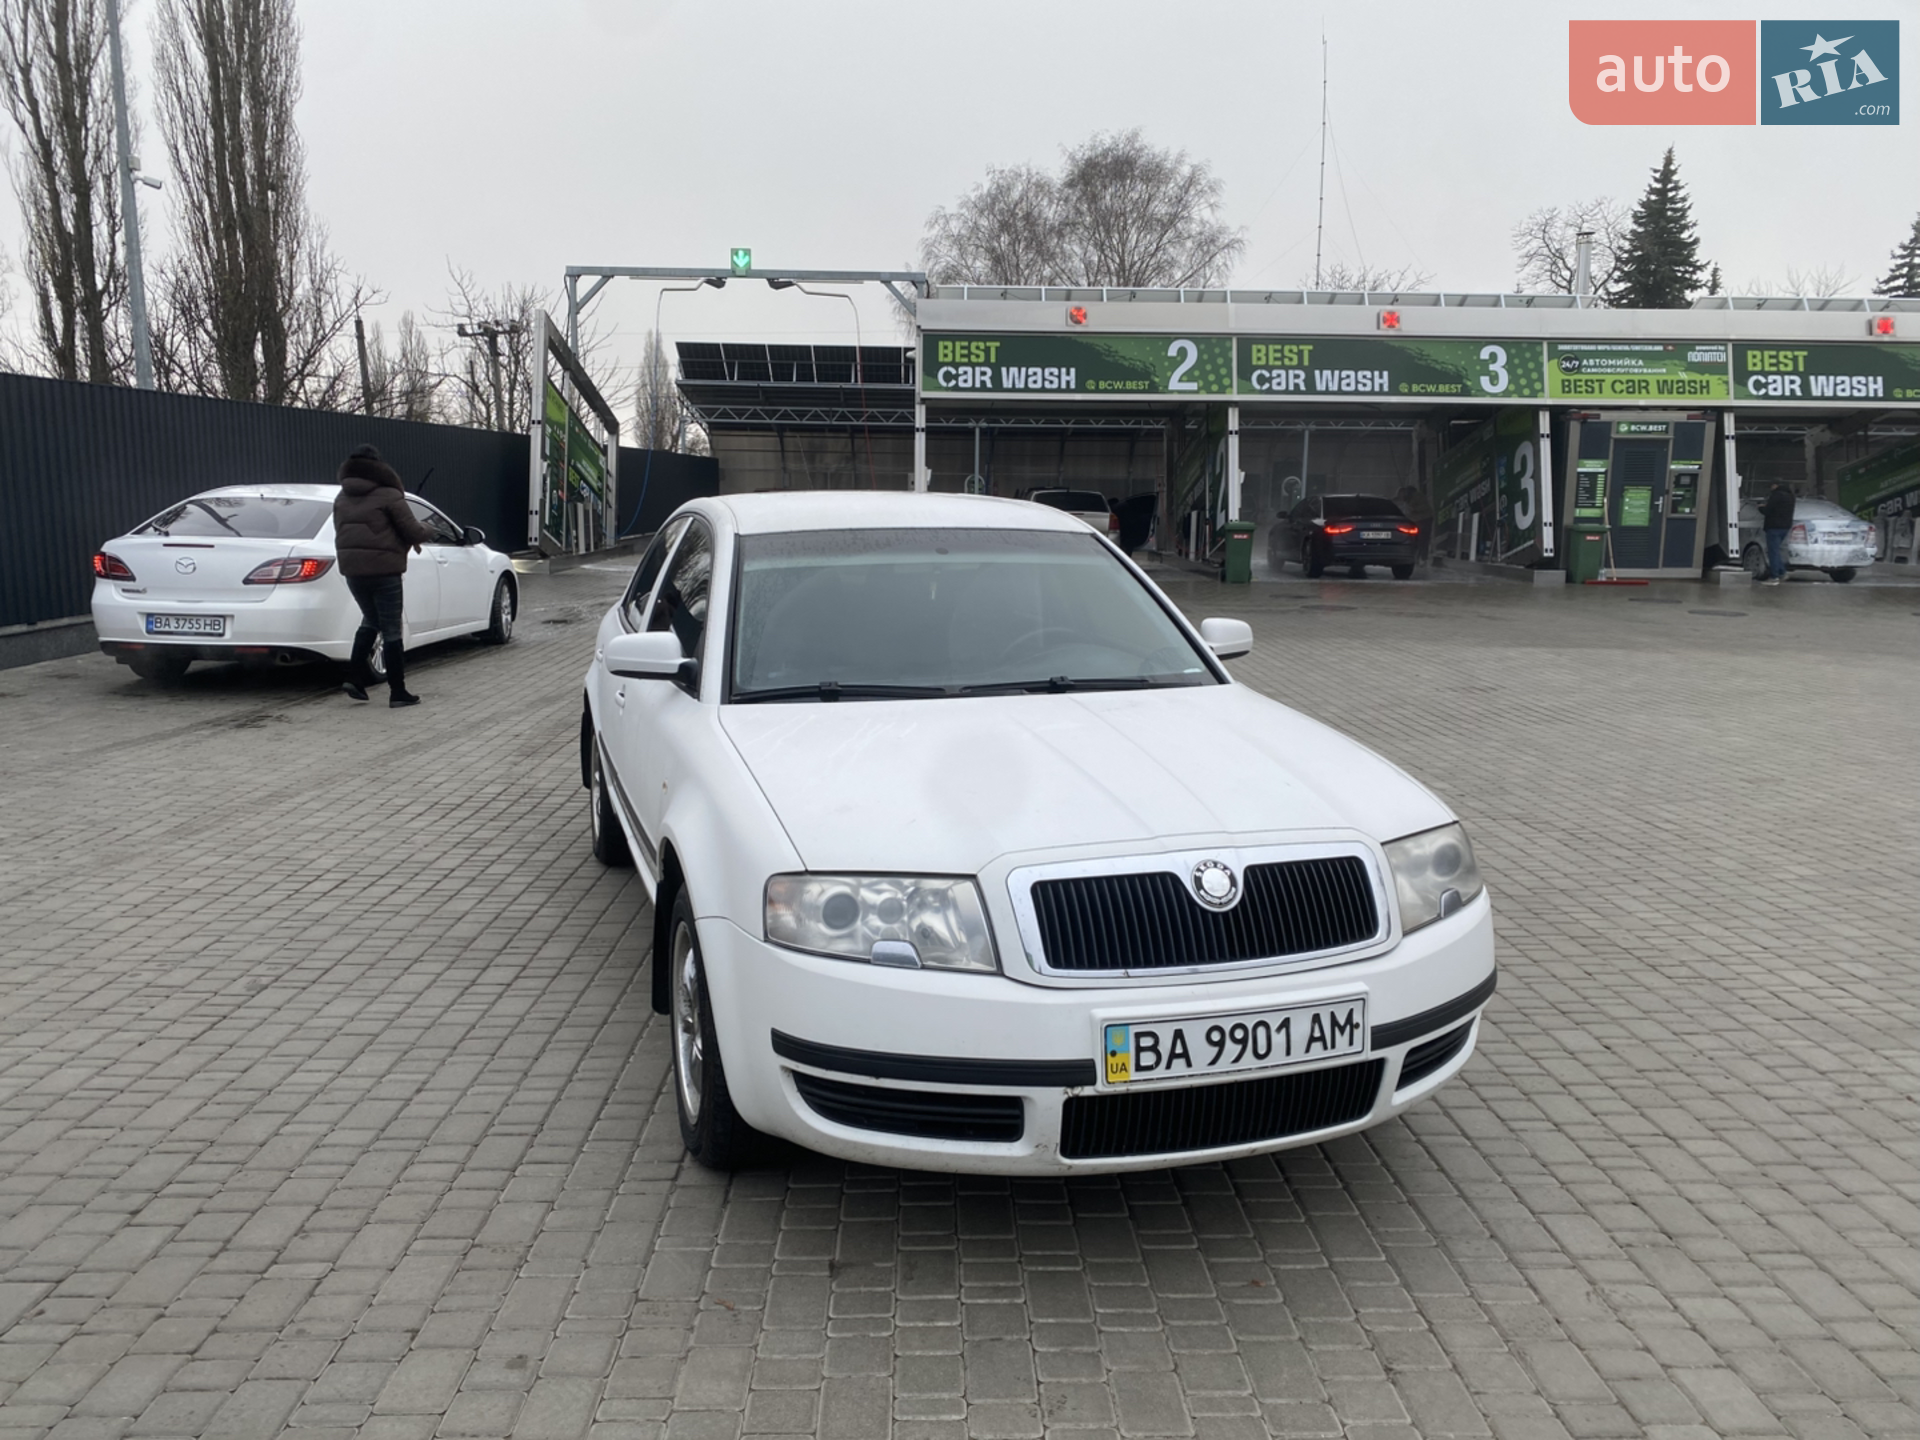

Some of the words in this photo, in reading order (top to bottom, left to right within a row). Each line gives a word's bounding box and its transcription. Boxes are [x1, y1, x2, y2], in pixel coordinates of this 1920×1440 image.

[937, 340, 1001, 363] BEST
[1251, 344, 1314, 367] BEST
[1746, 350, 1808, 372] BEST
[1166, 339, 1199, 391] 2
[1478, 344, 1510, 394] 3
[1561, 359, 1580, 369] 24/7
[1582, 358, 1645, 367] АВТОМИЙКА
[1098, 380, 1150, 391] BCW.BEST
[1411, 383, 1462, 393] BCW.BEST
[1561, 378, 1606, 395] BEST
[1513, 440, 1535, 530] 3
[154, 616, 172, 629] BA
[173, 617, 202, 631] 3755
[203, 619, 222, 632] HB
[1134, 1028, 1193, 1073] BA
[1205, 1016, 1292, 1066] 9901
[1304, 1007, 1355, 1054] AM
[1110, 1062, 1129, 1075] UA
